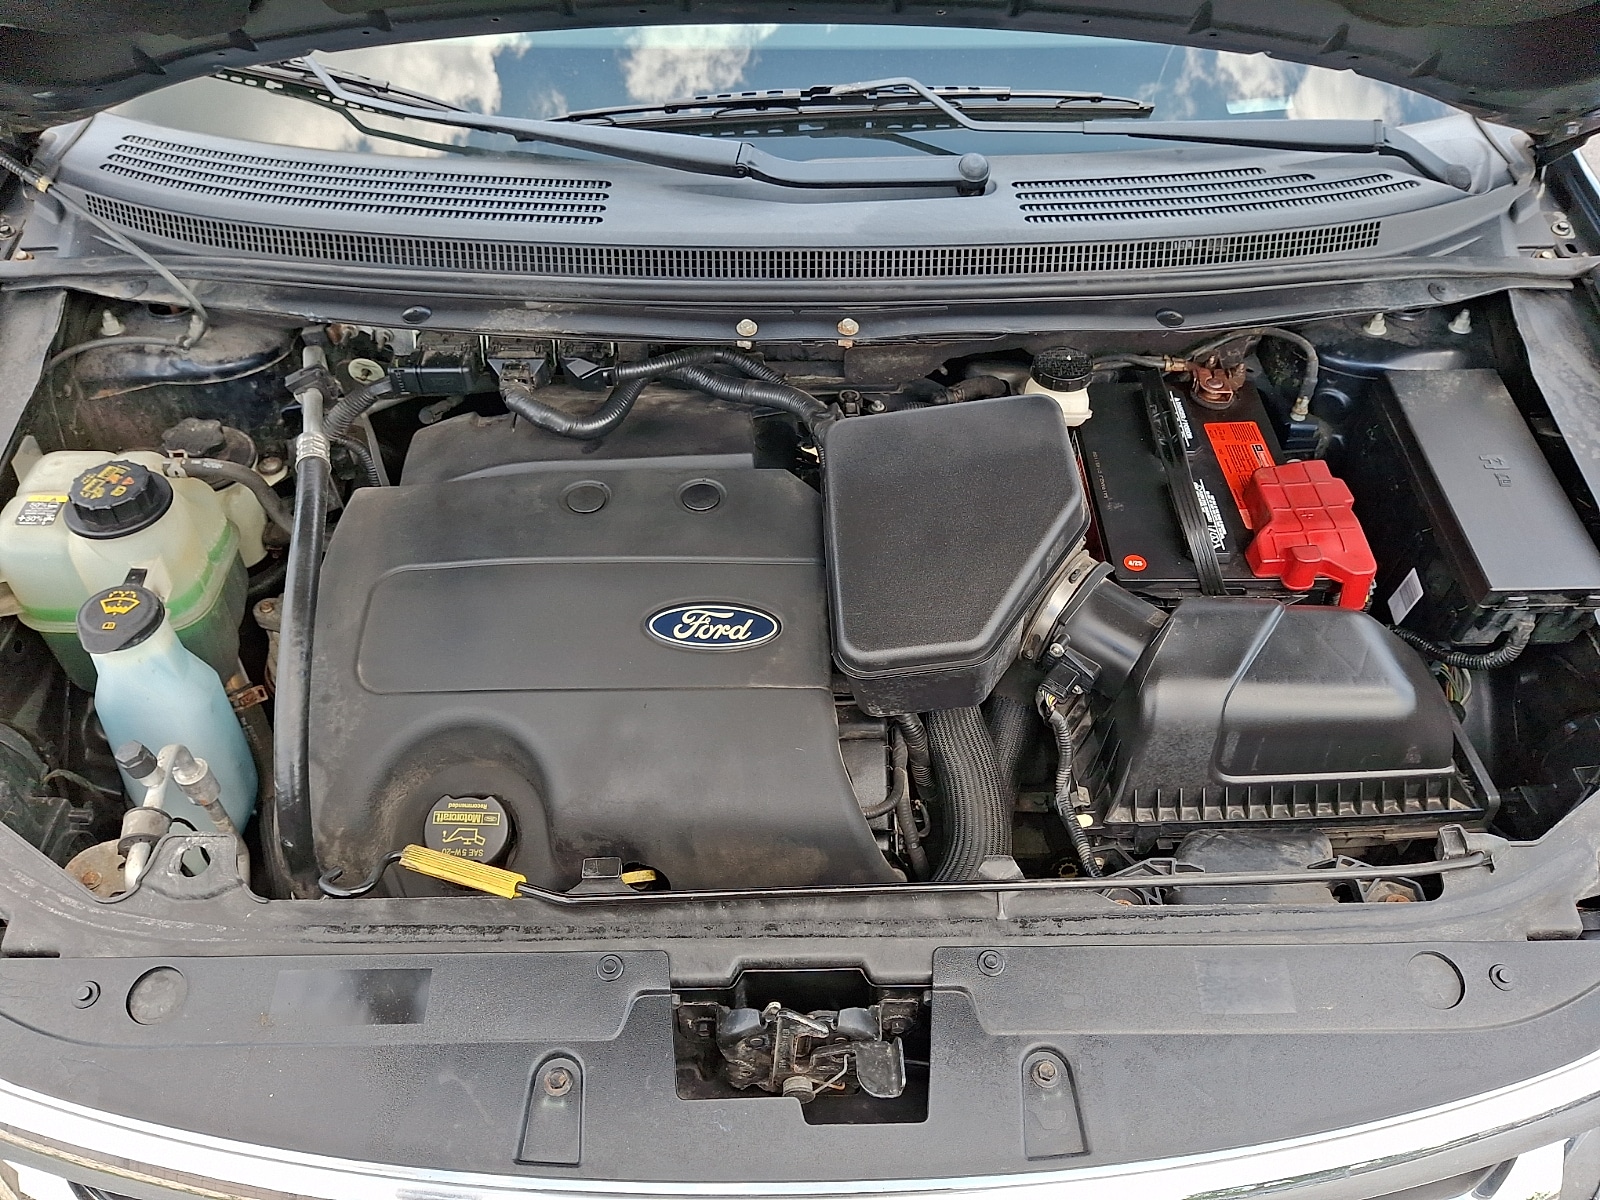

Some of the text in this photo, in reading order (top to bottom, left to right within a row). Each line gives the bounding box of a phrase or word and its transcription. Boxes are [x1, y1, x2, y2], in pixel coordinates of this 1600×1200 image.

[673, 609, 754, 640] Ford
[447, 802, 488, 810] Recommended
[435, 812, 482, 824] Motorcraft
[468, 848, 484, 857] SAE
